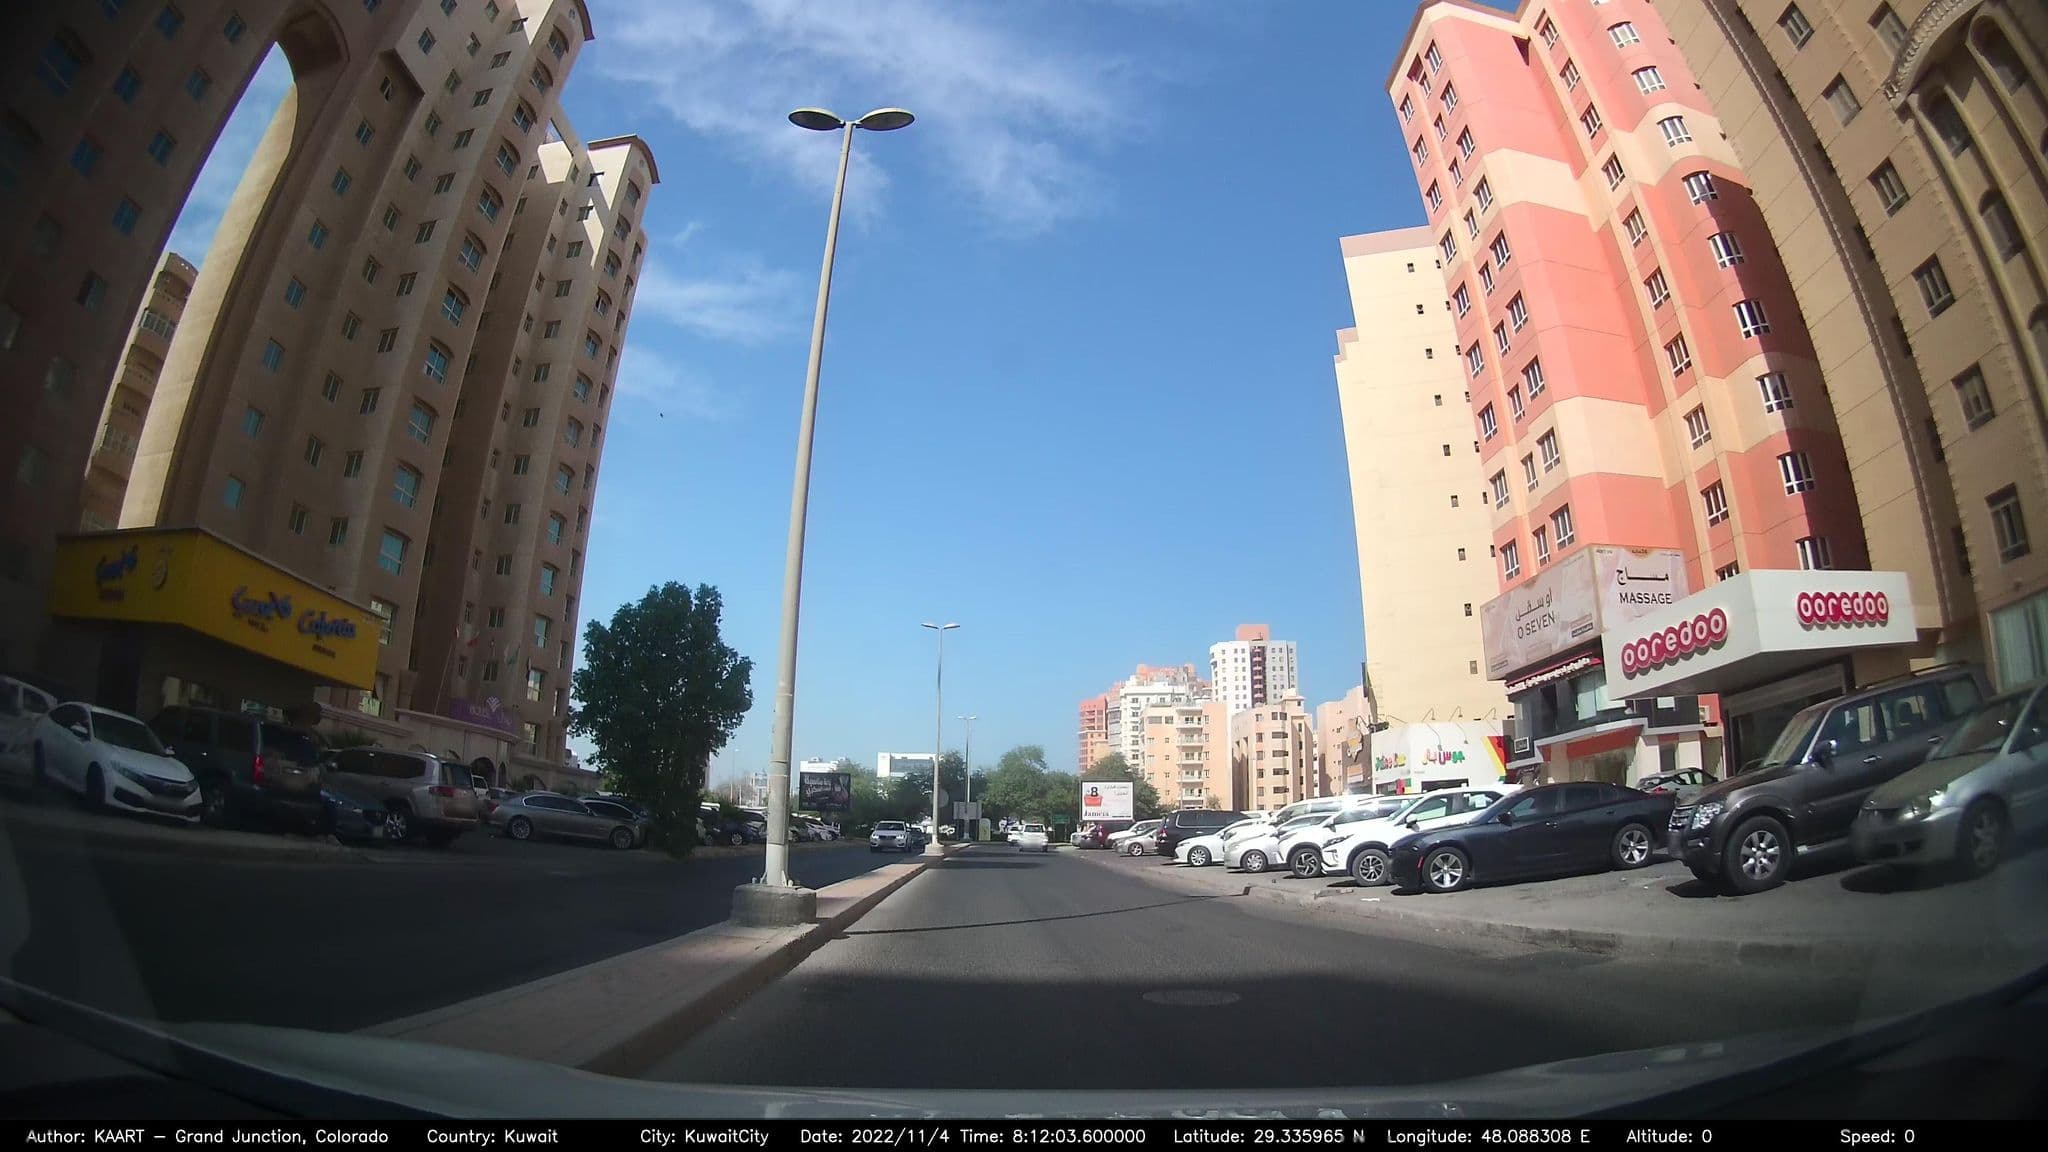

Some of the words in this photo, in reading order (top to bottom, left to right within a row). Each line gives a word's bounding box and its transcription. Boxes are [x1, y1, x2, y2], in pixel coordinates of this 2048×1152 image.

[1616, 566, 1669, 586] مساج
[1619, 592, 1673, 605] MASSAGE
[1796, 591, 1889, 624] ooredoo
[1517, 626, 1524, 639] O
[1526, 610, 1556, 636] SEVEN
[1621, 608, 1727, 673] ooredoo
